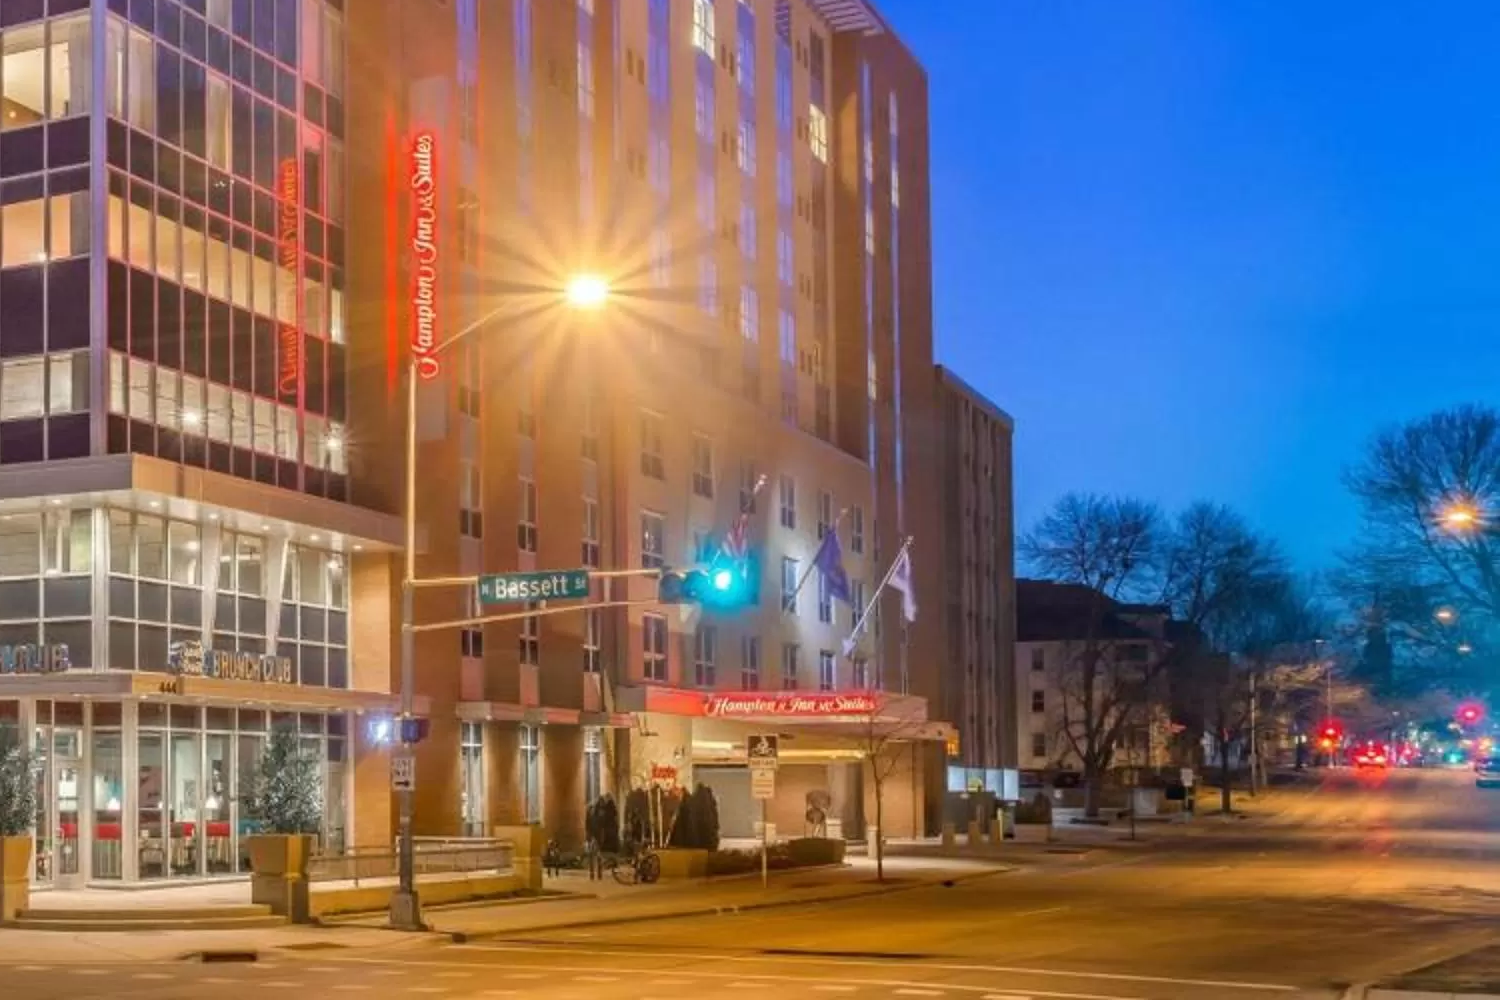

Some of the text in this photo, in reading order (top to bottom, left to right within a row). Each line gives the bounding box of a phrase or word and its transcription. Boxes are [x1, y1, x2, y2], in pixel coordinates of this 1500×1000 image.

[412, 135, 433, 192] Suites
[413, 206, 436, 263] Inn
[495, 575, 568, 599] Bassett
[213, 650, 262, 681] BRUNCH
[704, 694, 782, 716] Hampton
[782, 697, 820, 713] Inn
